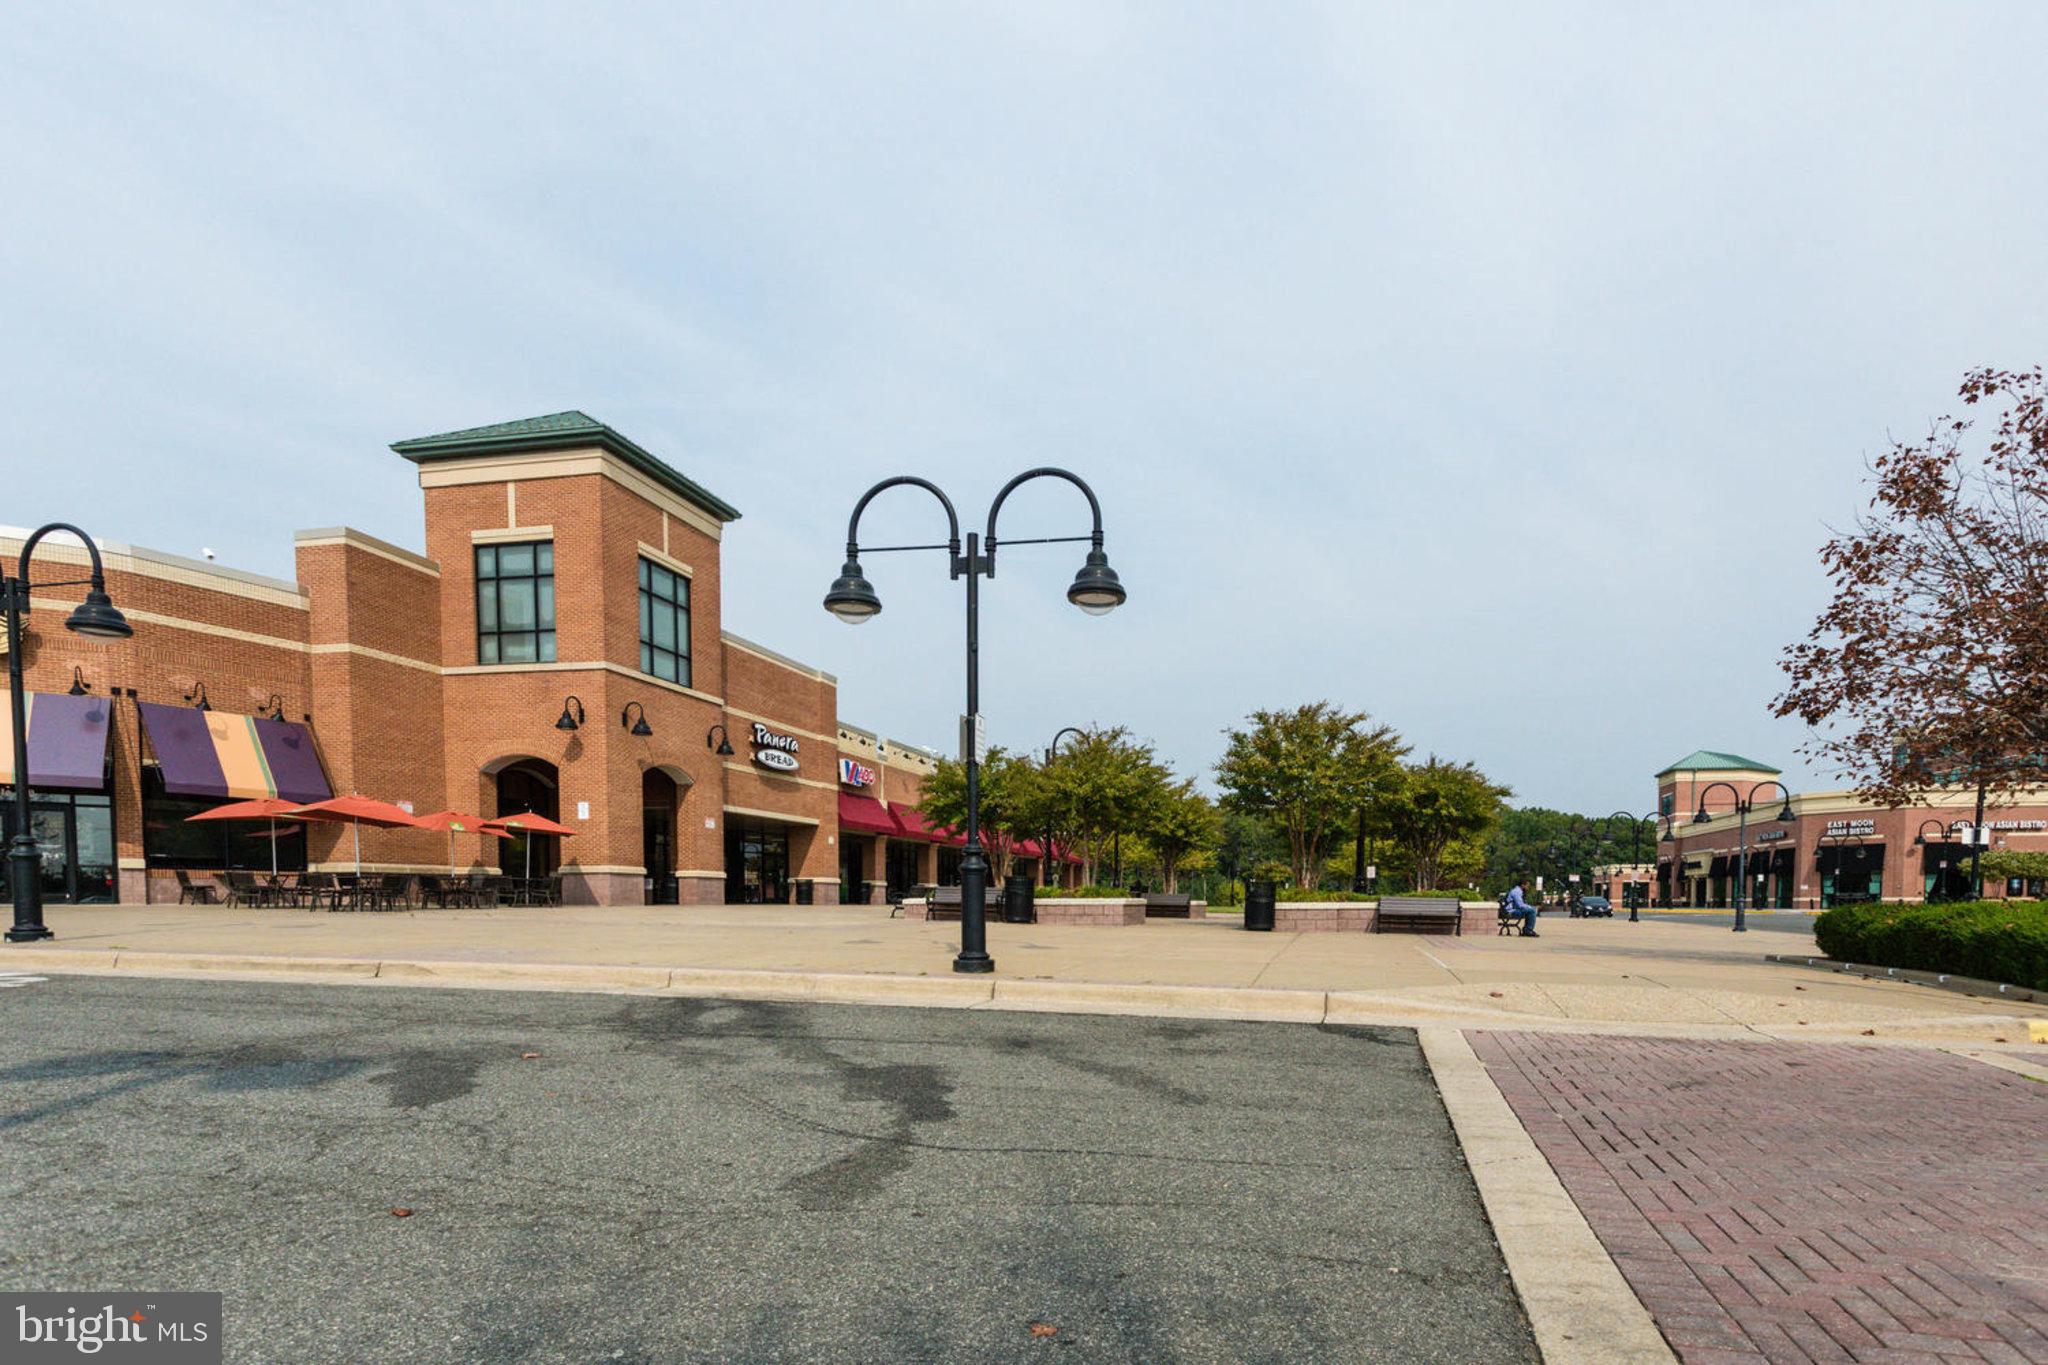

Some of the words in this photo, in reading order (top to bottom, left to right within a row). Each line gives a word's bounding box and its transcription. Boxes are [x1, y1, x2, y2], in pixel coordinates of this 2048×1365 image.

[754, 723, 799, 752] Panera
[764, 752, 794, 767] BREAD
[1828, 820, 1847, 828] EAST
[1850, 819, 1874, 827] MOON
[1996, 820, 2019, 829] ASIAN
[1826, 828, 1847, 836] ASIAN
